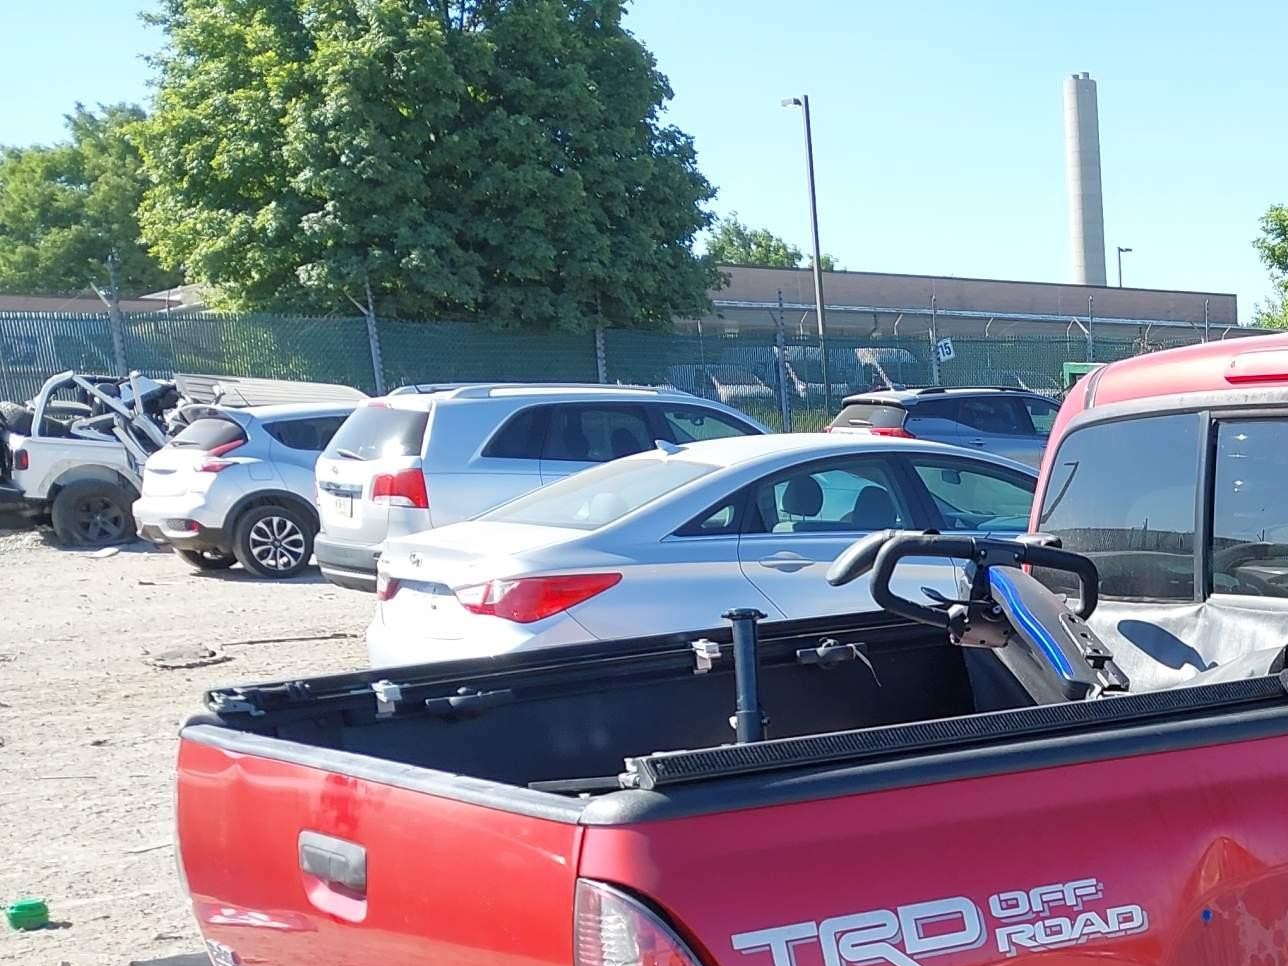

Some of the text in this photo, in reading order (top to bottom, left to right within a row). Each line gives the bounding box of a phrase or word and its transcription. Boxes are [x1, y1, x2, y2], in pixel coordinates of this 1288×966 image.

[939, 342, 952, 358] 15
[989, 878, 1104, 922] OFF
[994, 903, 1149, 957] ROAD
